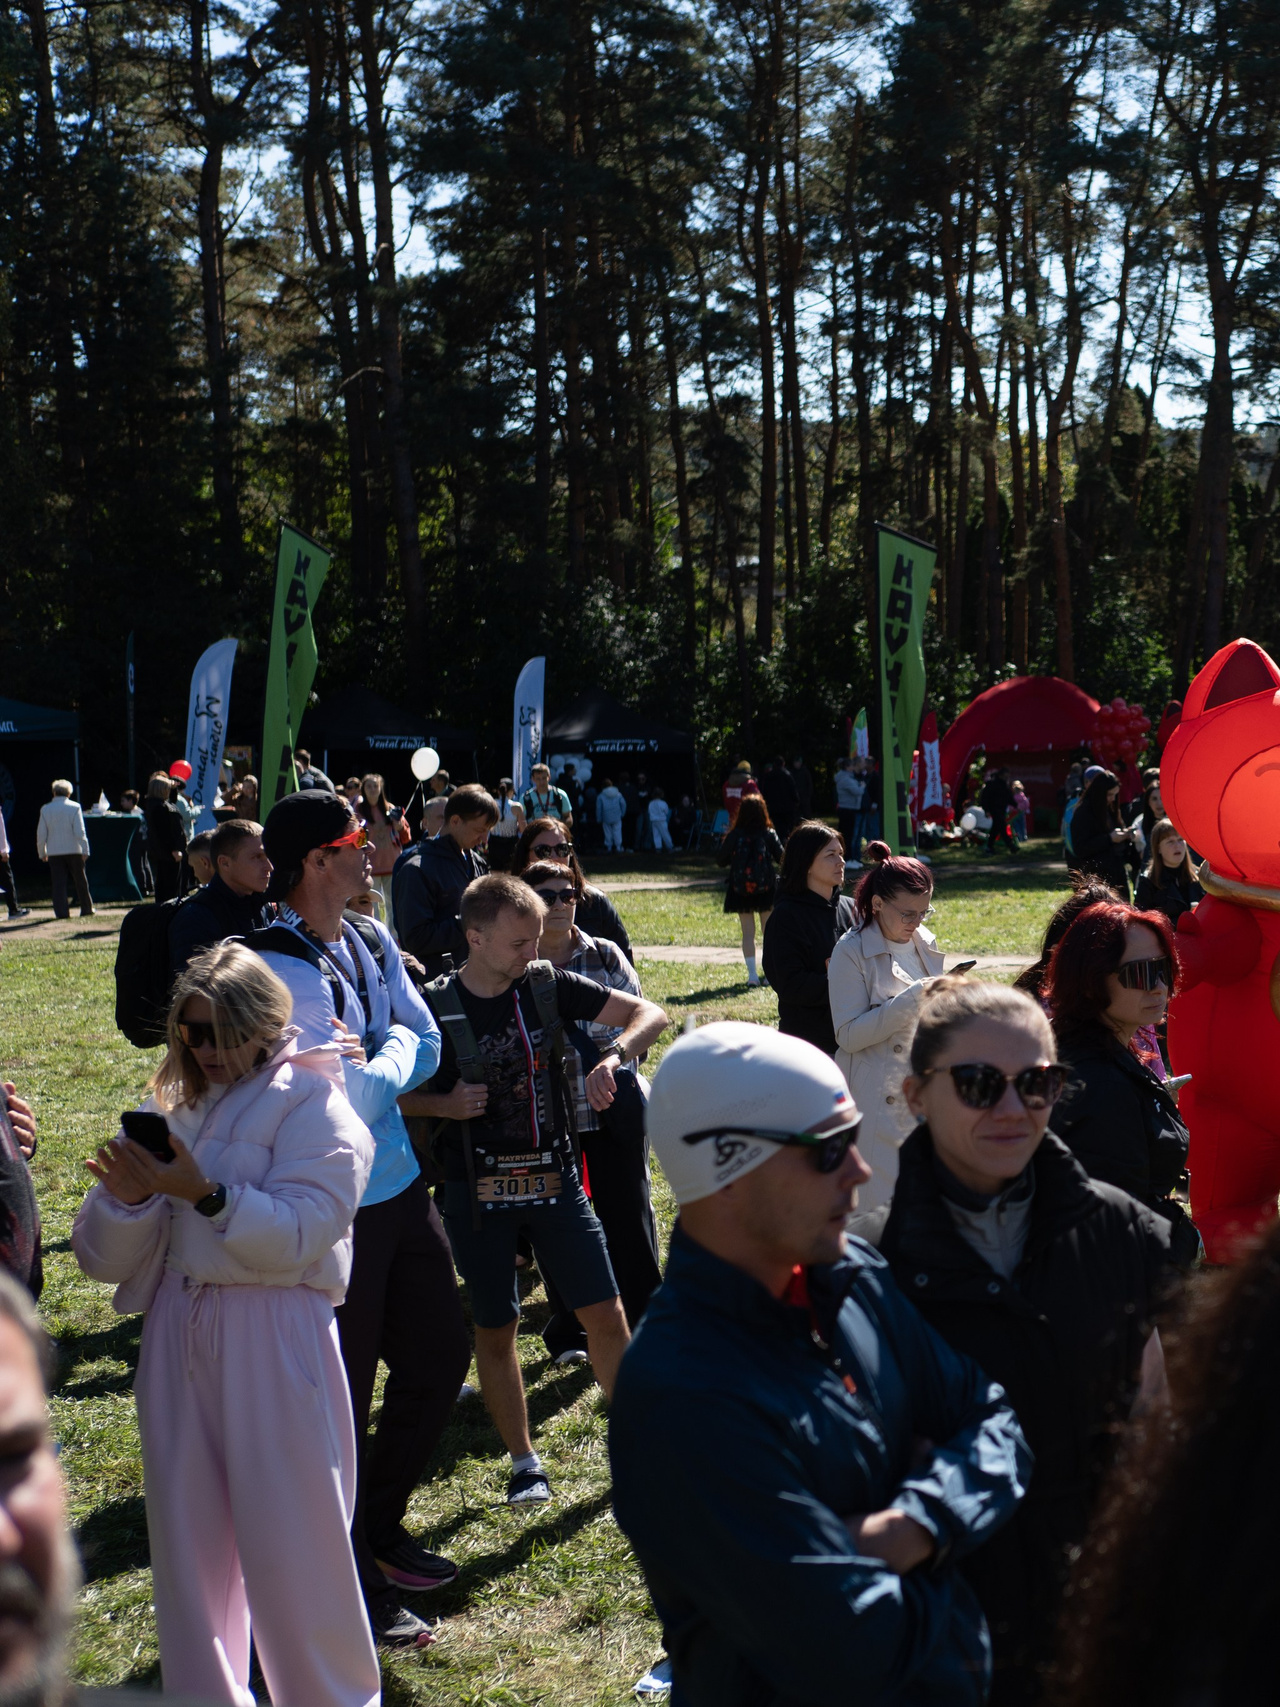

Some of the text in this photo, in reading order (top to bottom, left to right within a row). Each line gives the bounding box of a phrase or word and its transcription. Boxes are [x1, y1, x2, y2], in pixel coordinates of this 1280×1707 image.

[192, 746, 208, 803] Dental
[498, 1153, 541, 1162] MAYRVEDA
[493, 1175, 546, 1197] 3013
